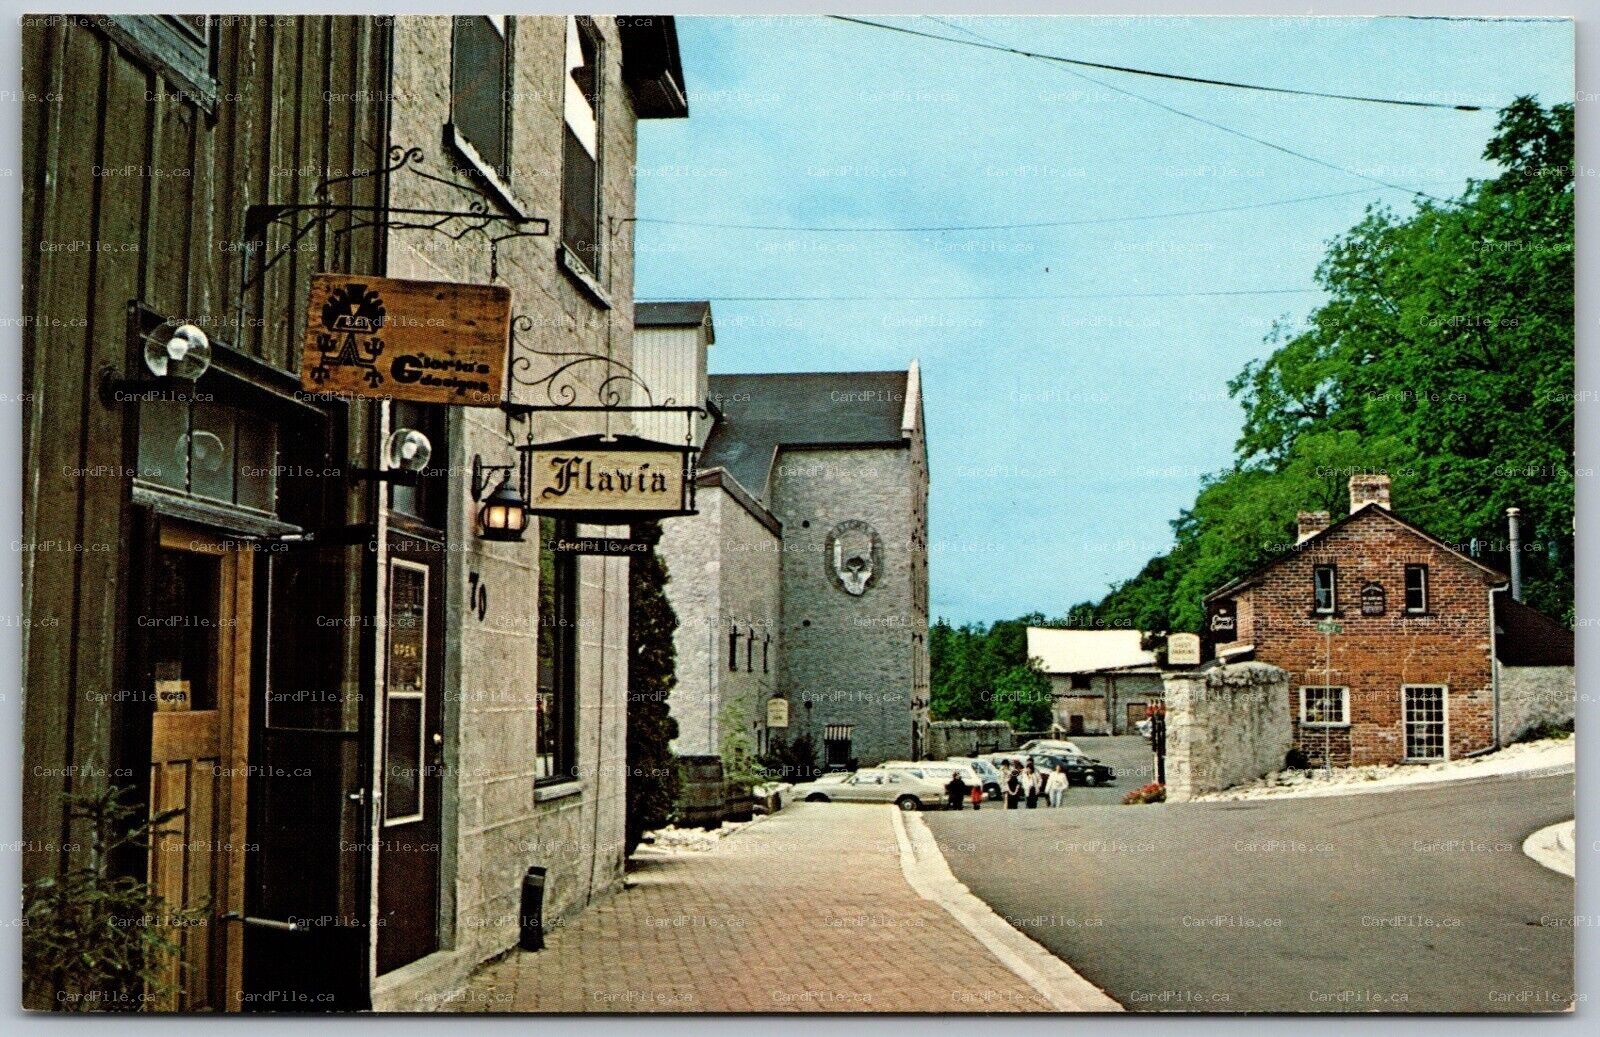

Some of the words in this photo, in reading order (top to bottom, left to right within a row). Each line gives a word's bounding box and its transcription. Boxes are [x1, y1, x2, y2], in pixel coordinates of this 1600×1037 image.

[391, 352, 490, 384] Gloria's
[541, 455, 668, 499] Flavia
[468, 571, 488, 622] 70
[393, 643, 418, 658] OPEN
